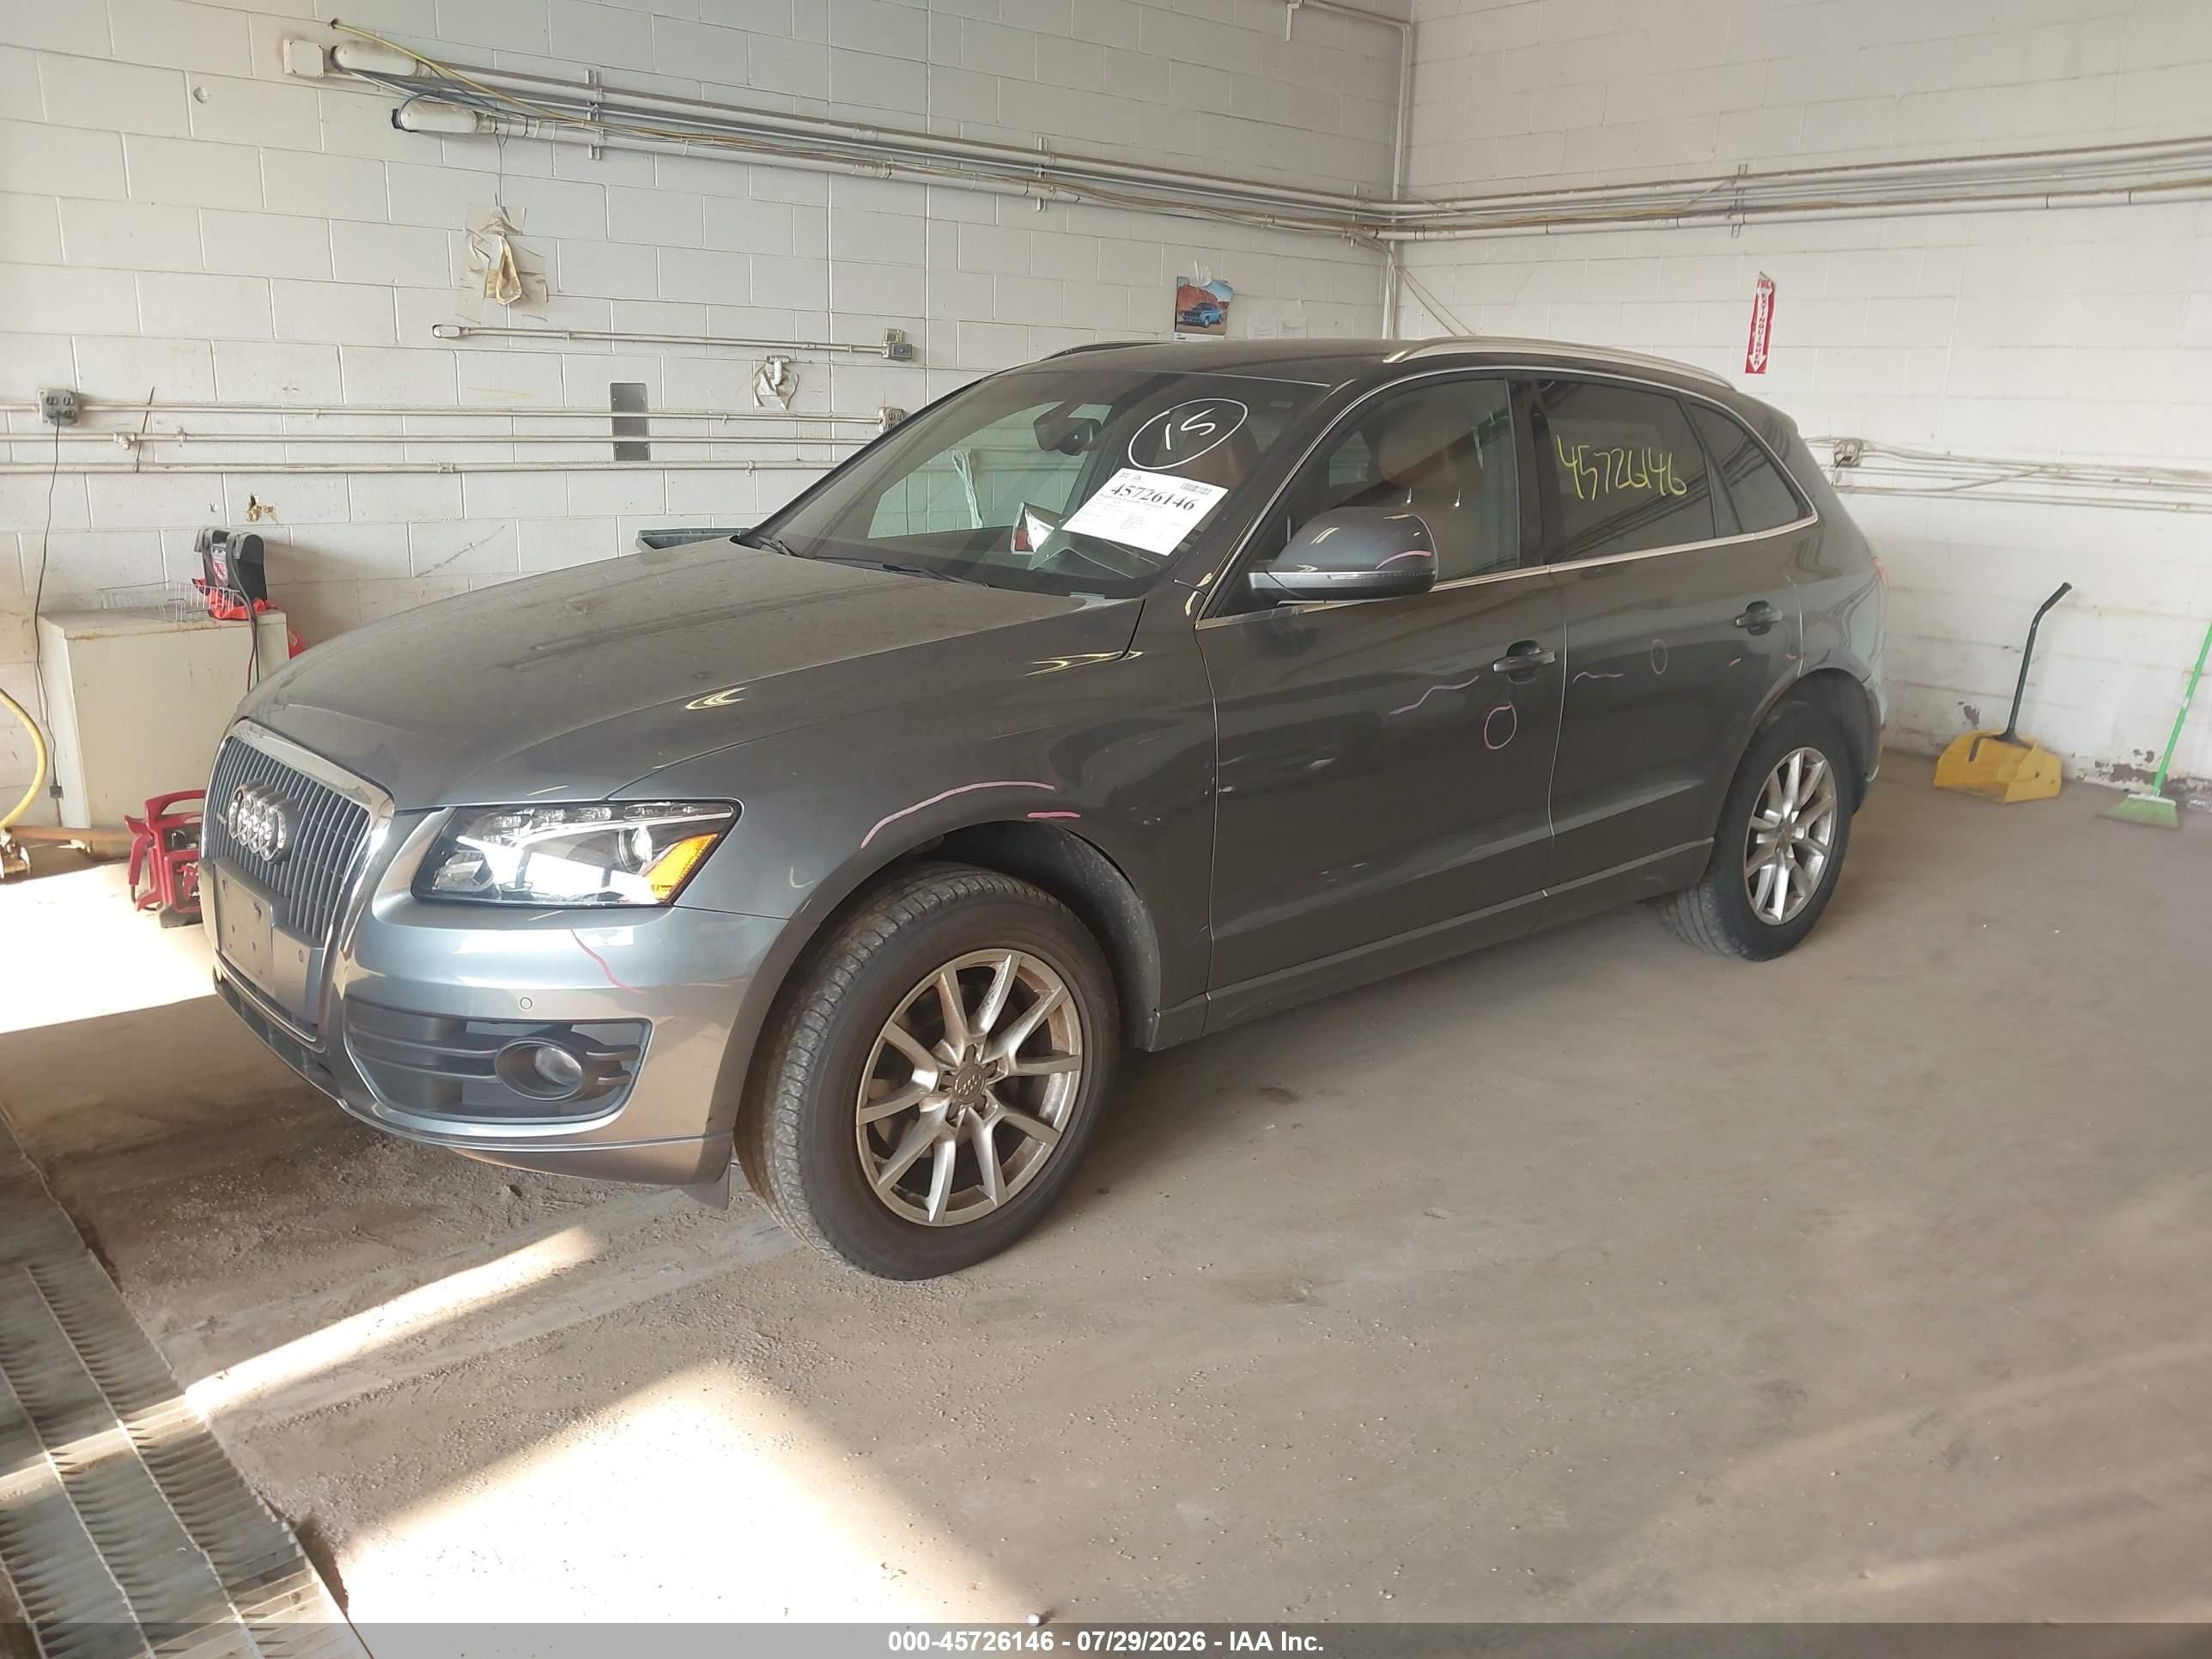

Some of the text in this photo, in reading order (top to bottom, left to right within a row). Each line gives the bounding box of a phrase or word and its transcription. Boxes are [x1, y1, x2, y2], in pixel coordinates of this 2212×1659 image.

[1757, 279, 1772, 289] FIRE
[1164, 407, 1217, 451] 15
[1110, 483, 1200, 511] 45726146
